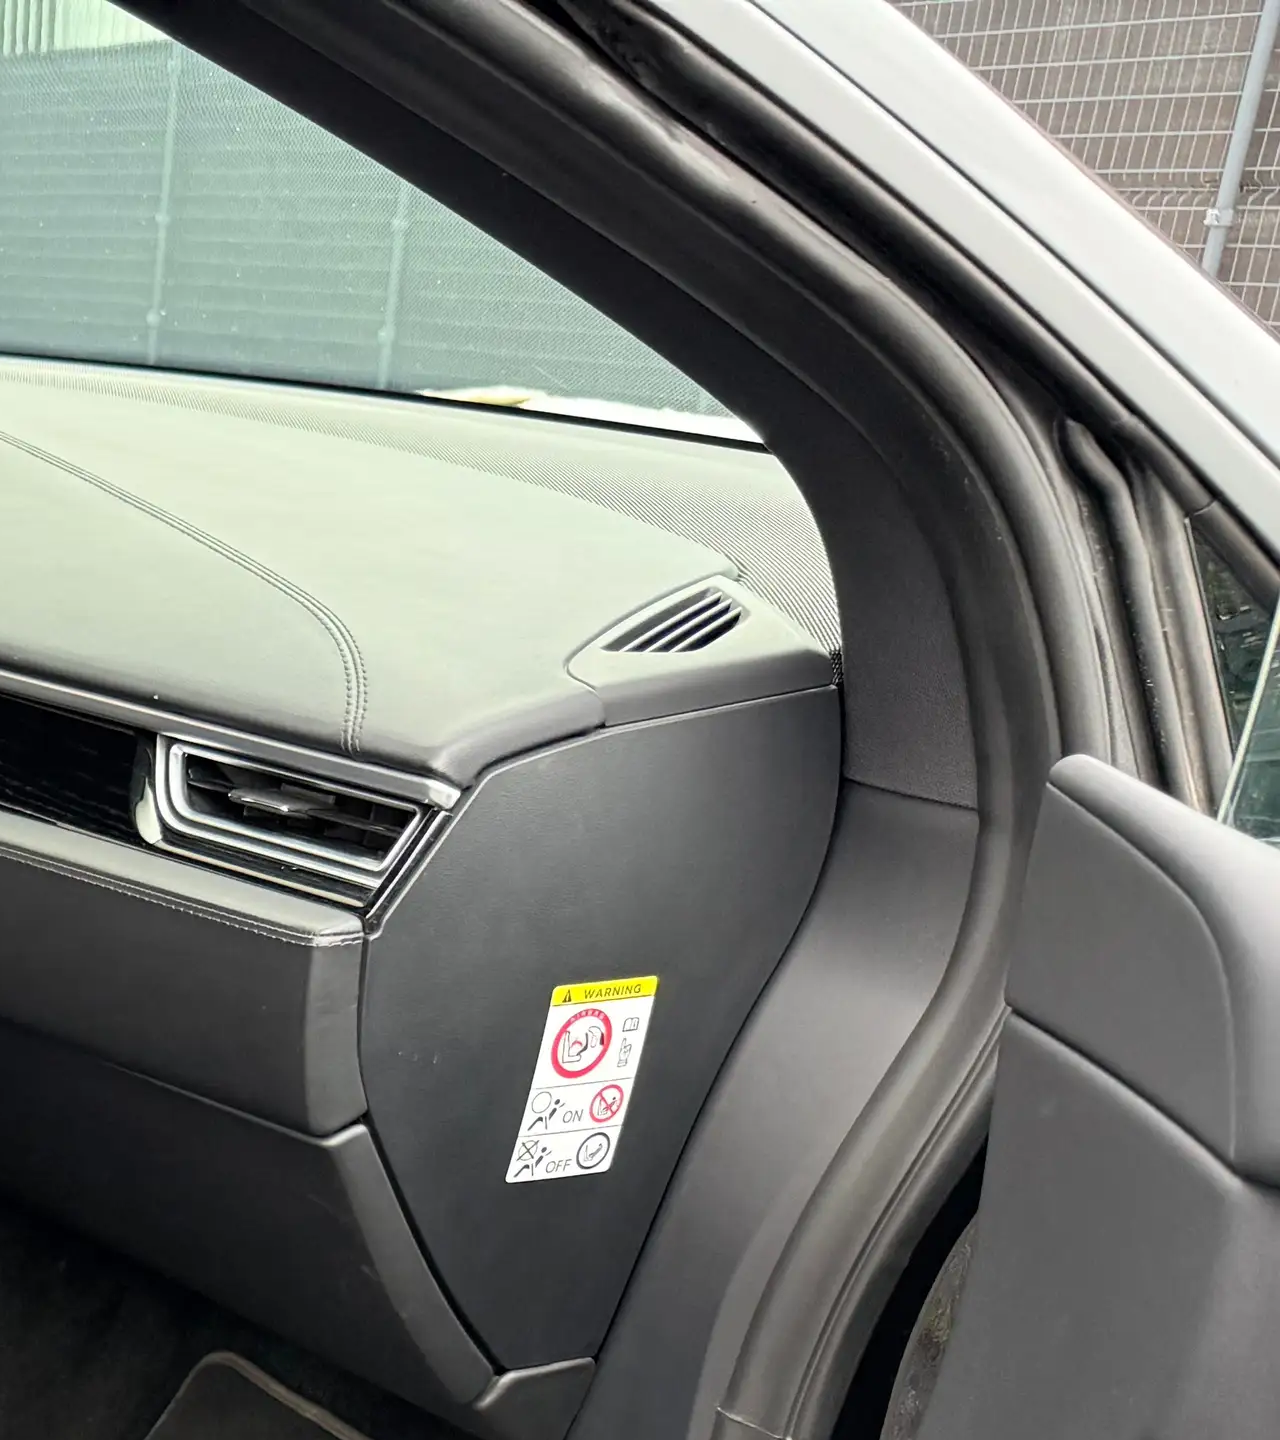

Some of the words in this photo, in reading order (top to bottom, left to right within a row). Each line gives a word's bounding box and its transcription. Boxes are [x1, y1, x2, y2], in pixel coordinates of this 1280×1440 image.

[584, 984, 641, 999] WARNING
[562, 1109, 584, 1123] ON
[545, 1159, 571, 1173] OFF
